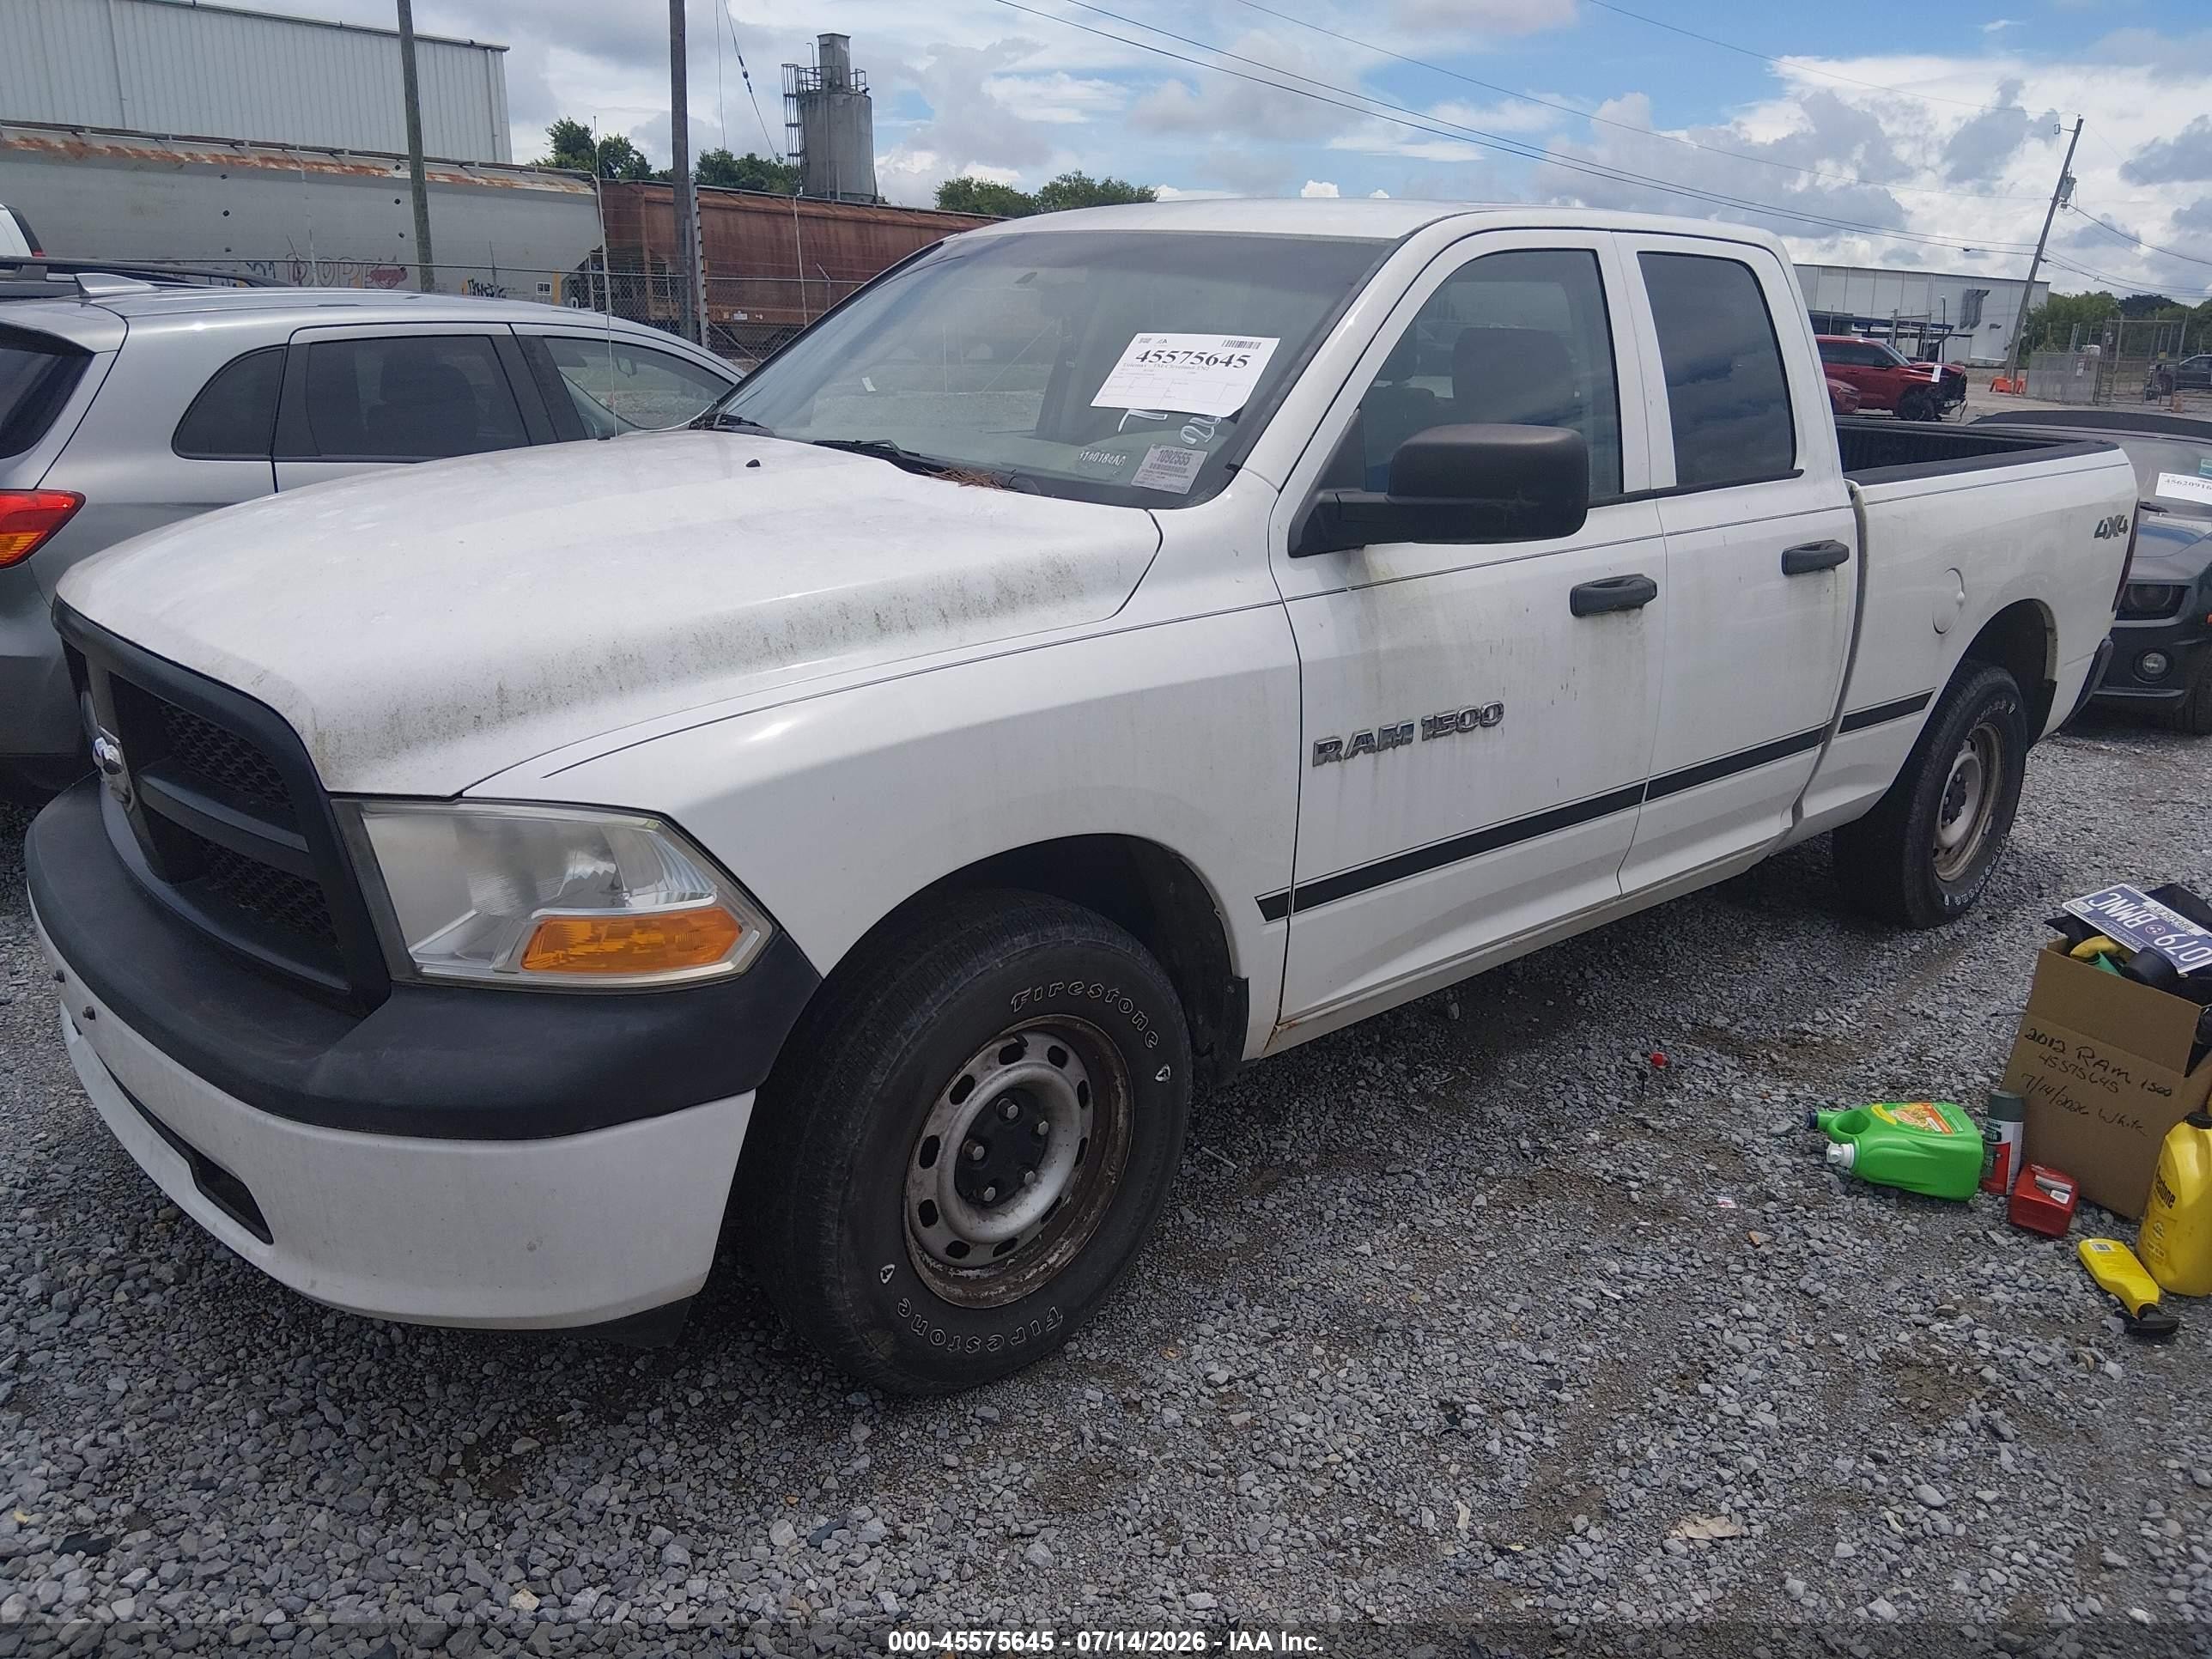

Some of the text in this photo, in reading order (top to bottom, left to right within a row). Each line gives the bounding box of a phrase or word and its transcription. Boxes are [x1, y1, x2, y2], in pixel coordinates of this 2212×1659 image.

[1135, 349, 1251, 369] 45575645
[1312, 700, 1504, 768] RAM 1500
[2087, 892, 2159, 929] BMNC
[2150, 906, 2195, 930] BRADLEY
[1011, 981, 1159, 1048] Firestone
[2025, 1028, 2066, 1054] 2012
[2141, 1079, 2172, 1097] 1500
[2039, 1051, 2119, 1094] 45575645
[2021, 1073, 2148, 1137] 7/14/2026 White
[897, 1298, 1063, 1353] Firestone
